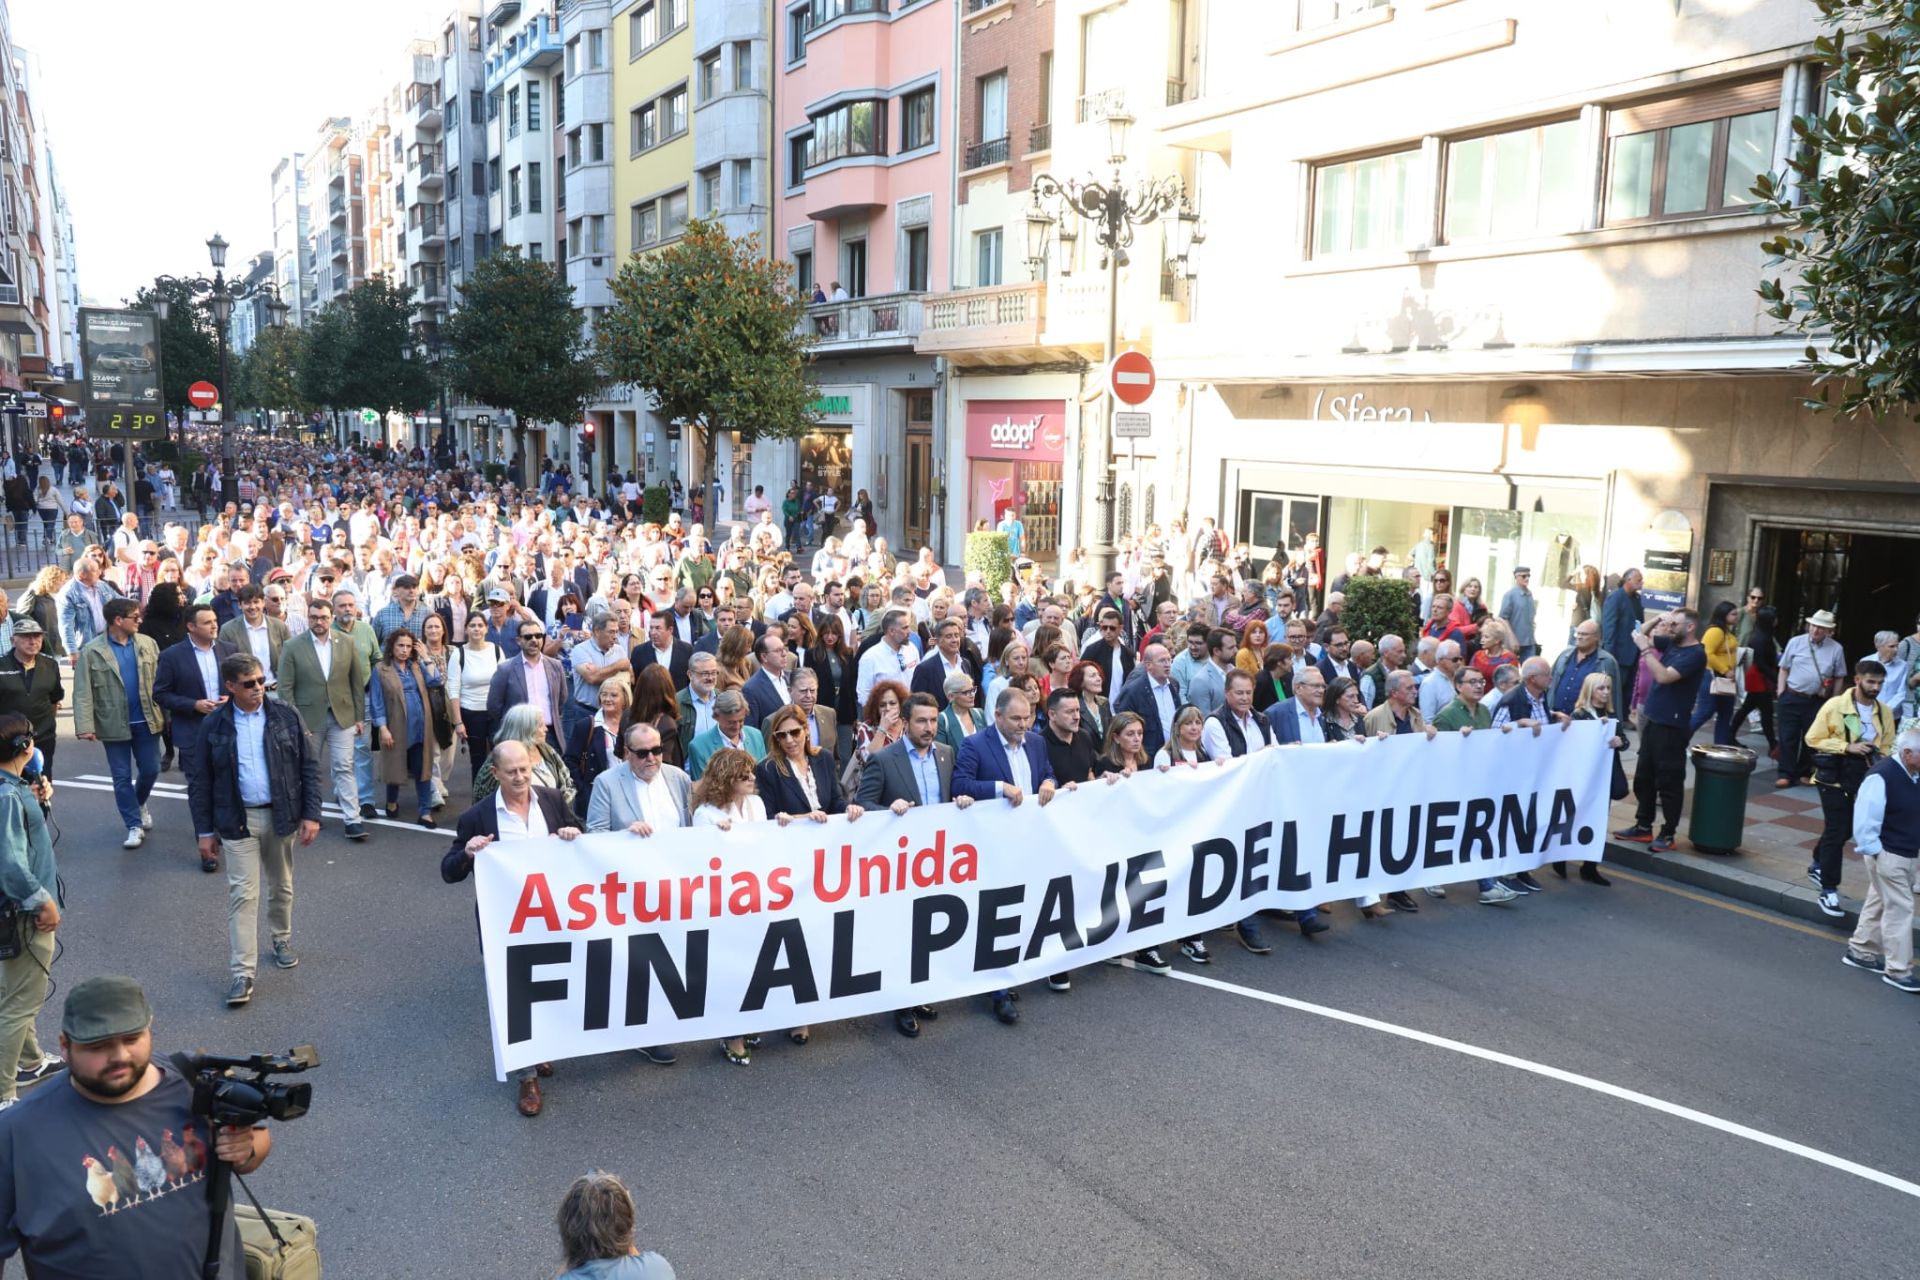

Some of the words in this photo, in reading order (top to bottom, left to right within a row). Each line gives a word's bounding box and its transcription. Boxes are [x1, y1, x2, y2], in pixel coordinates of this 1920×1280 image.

[991, 416, 1036, 446] adopt
[506, 928, 709, 1046] FIN
[739, 909, 882, 1012] AL
[911, 849, 1168, 985] PEAJE
[1187, 820, 1312, 917] DEL
[1326, 788, 1595, 884] HUERNA.
[509, 857, 794, 934] Asturias
[813, 830, 979, 904] Unida
